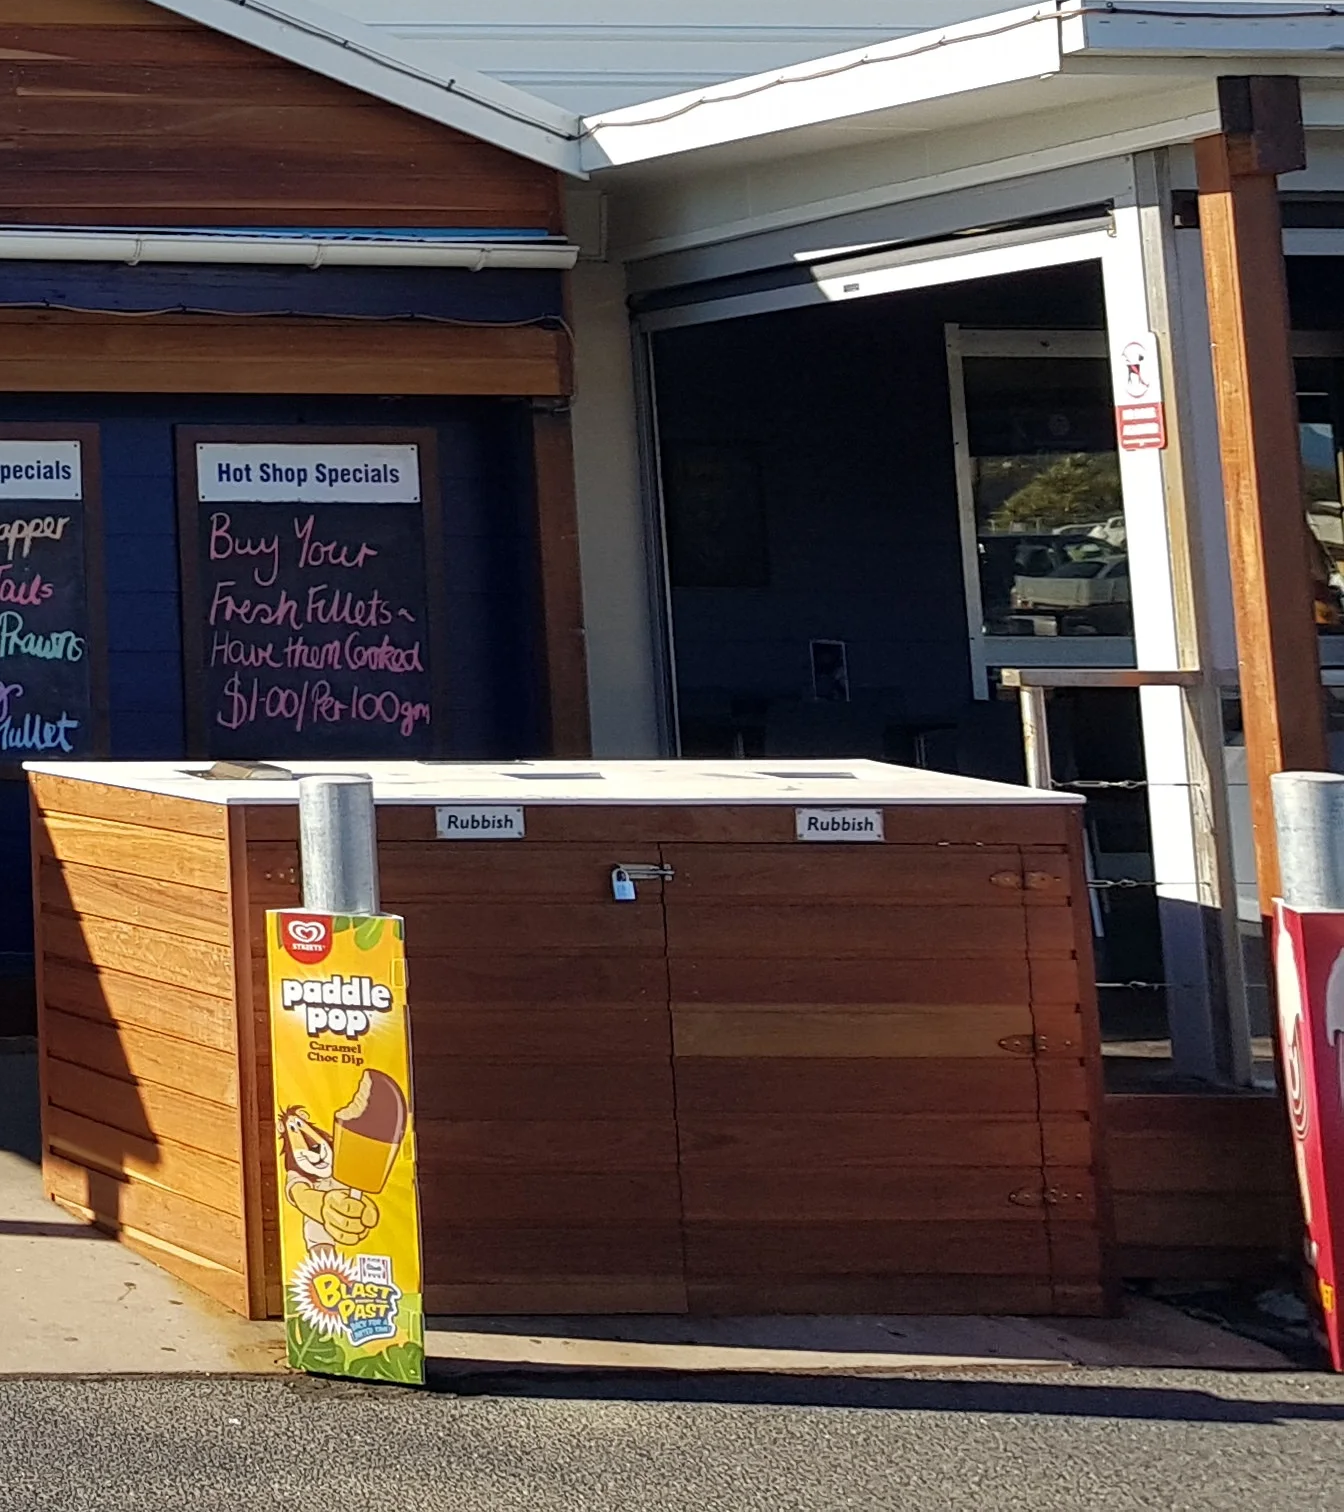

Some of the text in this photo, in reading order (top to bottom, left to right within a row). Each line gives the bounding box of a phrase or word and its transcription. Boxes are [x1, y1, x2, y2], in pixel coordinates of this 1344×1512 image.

[218, 462, 400, 487] Hot Shop Specials
[209, 511, 379, 586] Buy Your
[209, 581, 303, 631] Fresh
[211, 631, 284, 668] Have
[447, 814, 514, 830] Rubbish
[807, 816, 875, 833] Rubbish
[282, 975, 391, 1012] paddle
[306, 1006, 369, 1041] pop
[307, 1052, 364, 1066] Choc Dip
[309, 1041, 362, 1054] Caramel
[338, 1299, 389, 1325] PAST
